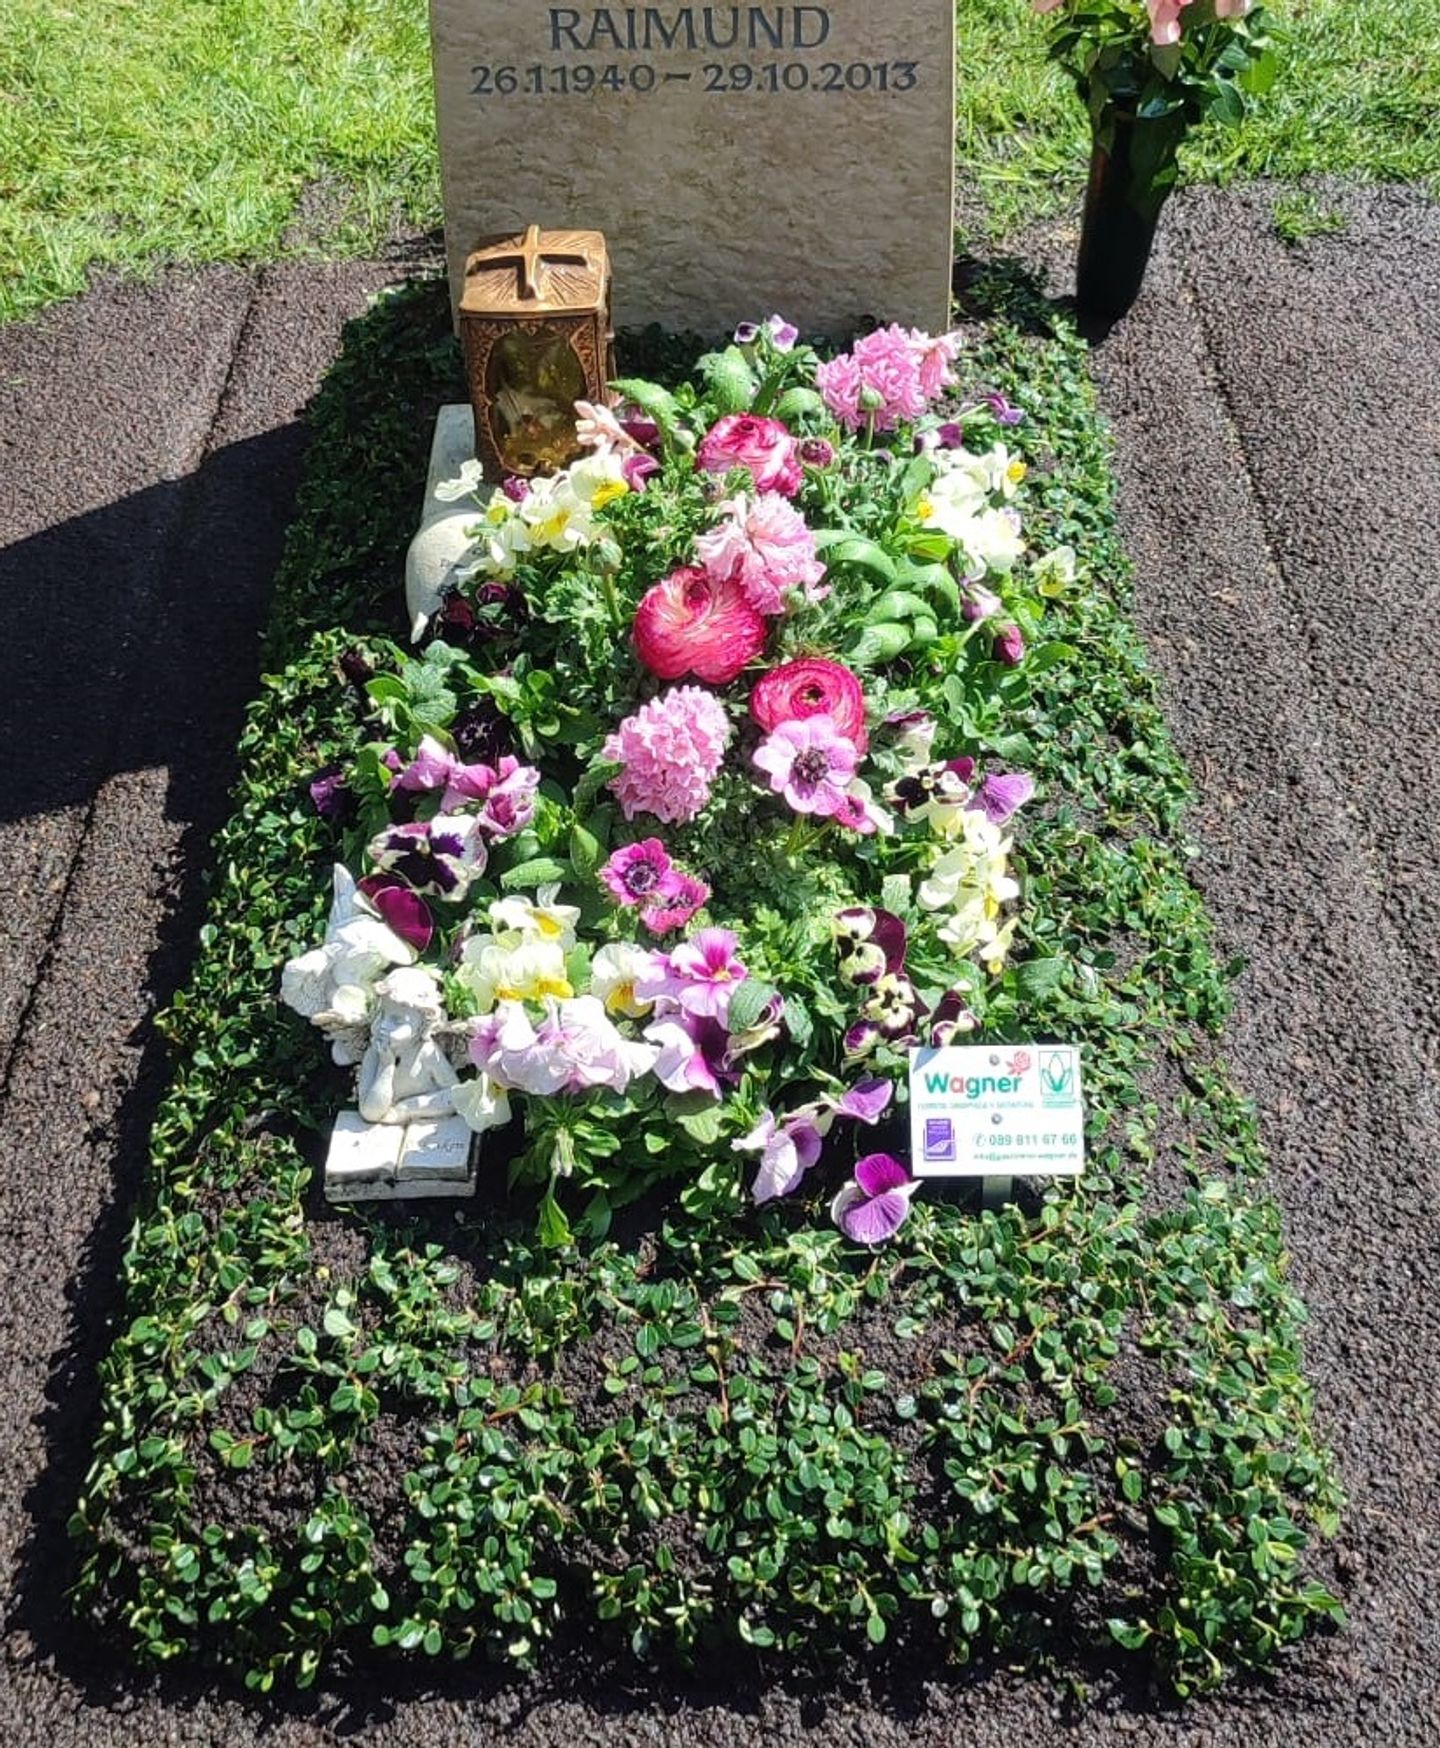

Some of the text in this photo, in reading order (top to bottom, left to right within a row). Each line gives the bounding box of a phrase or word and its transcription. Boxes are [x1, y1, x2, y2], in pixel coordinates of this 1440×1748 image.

[549, 7, 831, 50] RAIMUND
[470, 63, 656, 94] 26.1.1940
[703, 61, 919, 92] 29.10.2013
[924, 1072, 1022, 1099] Wagner
[989, 1134, 1012, 1146] 089
